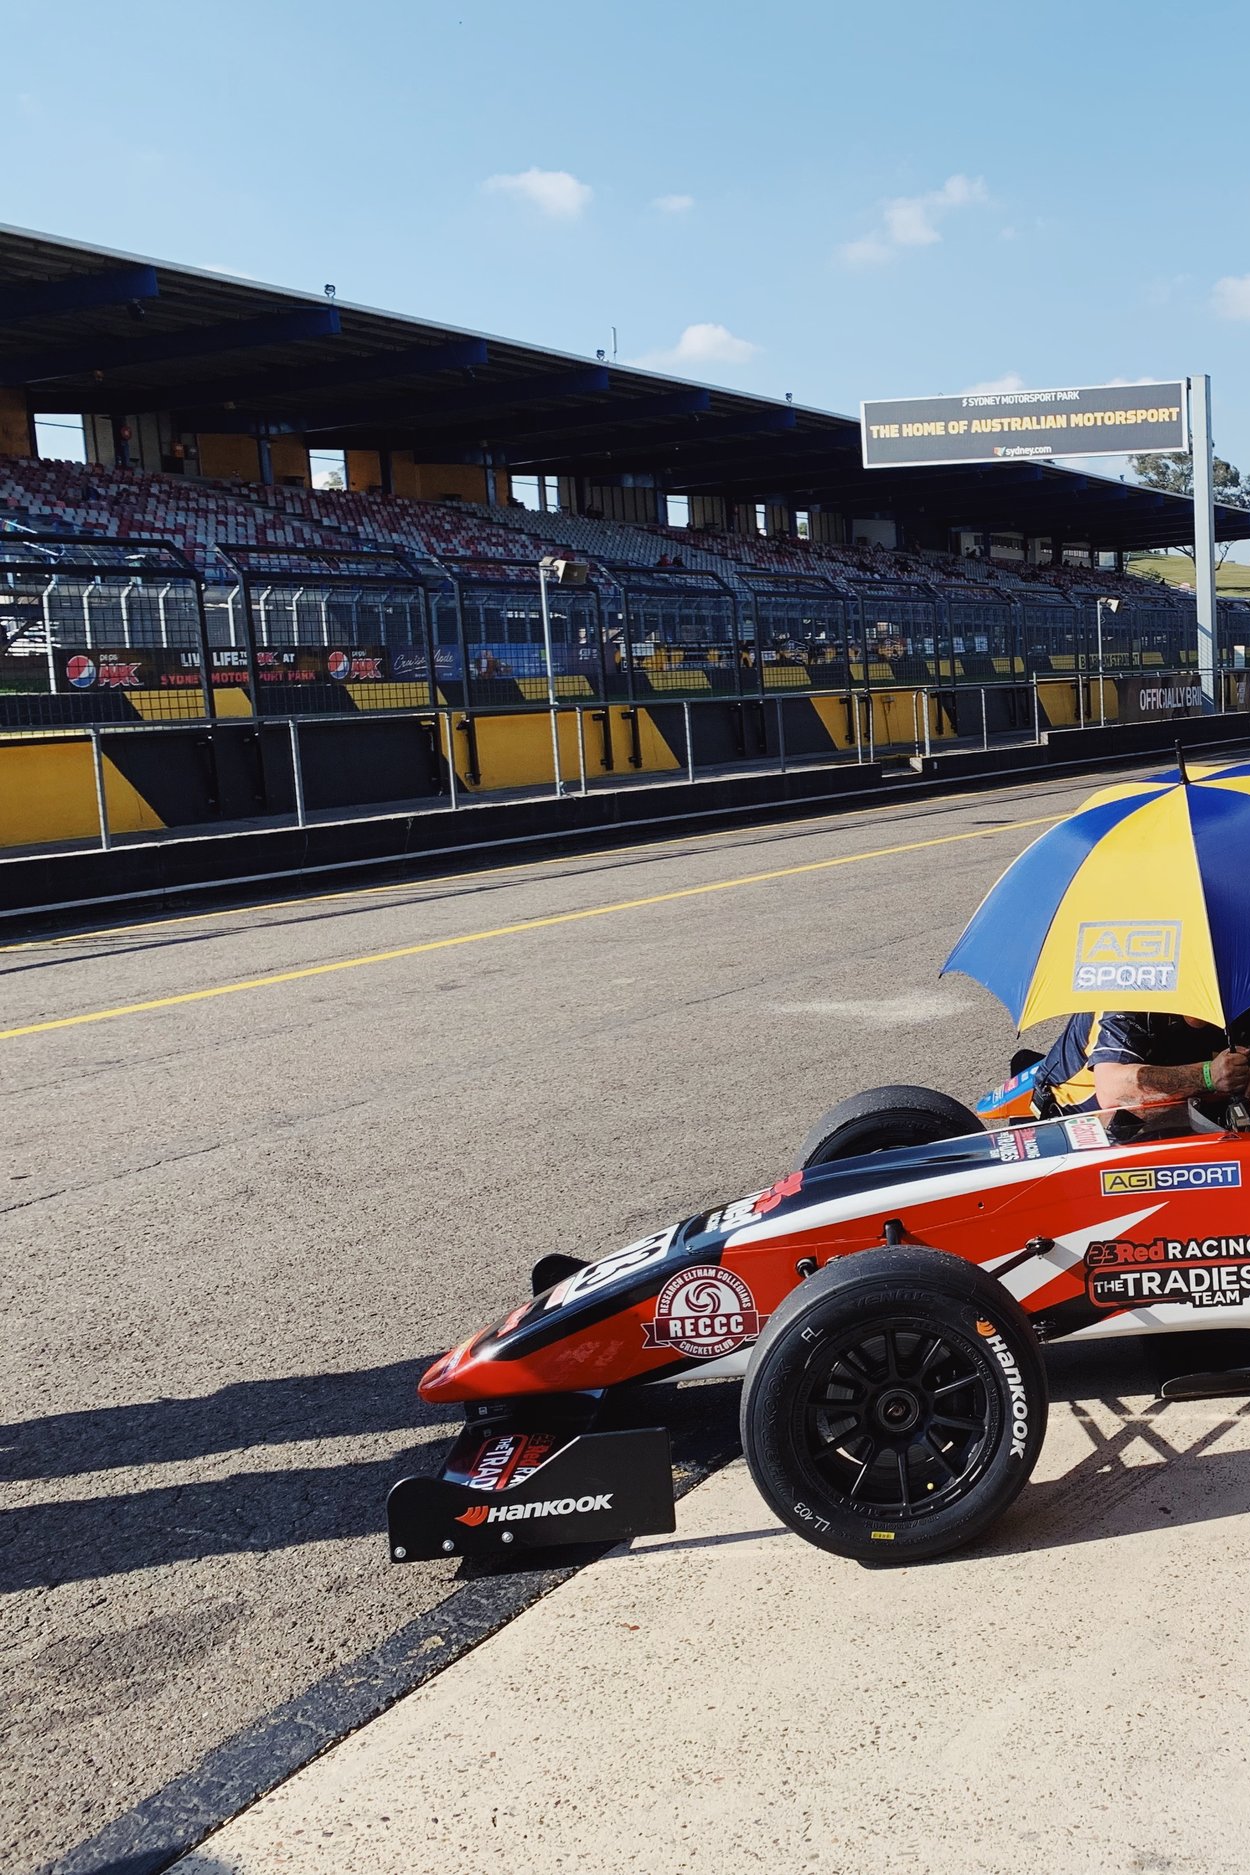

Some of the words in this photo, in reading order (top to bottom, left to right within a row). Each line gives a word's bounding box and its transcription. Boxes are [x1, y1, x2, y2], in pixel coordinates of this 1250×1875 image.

[968, 397, 999, 407] SYDNEY
[1001, 392, 1056, 404] MOTORSPORT
[1057, 390, 1080, 401] PARK
[870, 424, 899, 439] THE
[902, 421, 946, 438] HOME
[948, 420, 968, 435] OF
[971, 414, 1067, 434] AUSTRALIAN
[1070, 407, 1179, 428] MOTORSPORT
[1005, 445, 1052, 458] sydney.com
[181, 652, 200, 667] LIV
[213, 652, 239, 666] LIFE
[282, 653, 295, 663] AT
[160, 674, 199, 686] SYDNE
[212, 671, 283, 684] MOTORPORT
[288, 670, 316, 681] PARK
[1140, 687, 1184, 710] OFFICIALLY
[1087, 930, 1171, 960] AGI
[1078, 965, 1174, 986] SPORT
[1109, 1173, 1152, 1189] AGI
[1157, 1167, 1236, 1187] SPORT
[659, 1277, 685, 1314] RESEARCH
[683, 1268, 716, 1281] ELTHAM
[717, 1270, 751, 1308] COLLEGIANS
[1094, 1280, 1125, 1294] THE
[1192, 1290, 1240, 1305] TEAM
[669, 1315, 744, 1338] RECCC
[680, 1341, 712, 1355] CRICKET
[714, 1339, 735, 1353] CLUB
